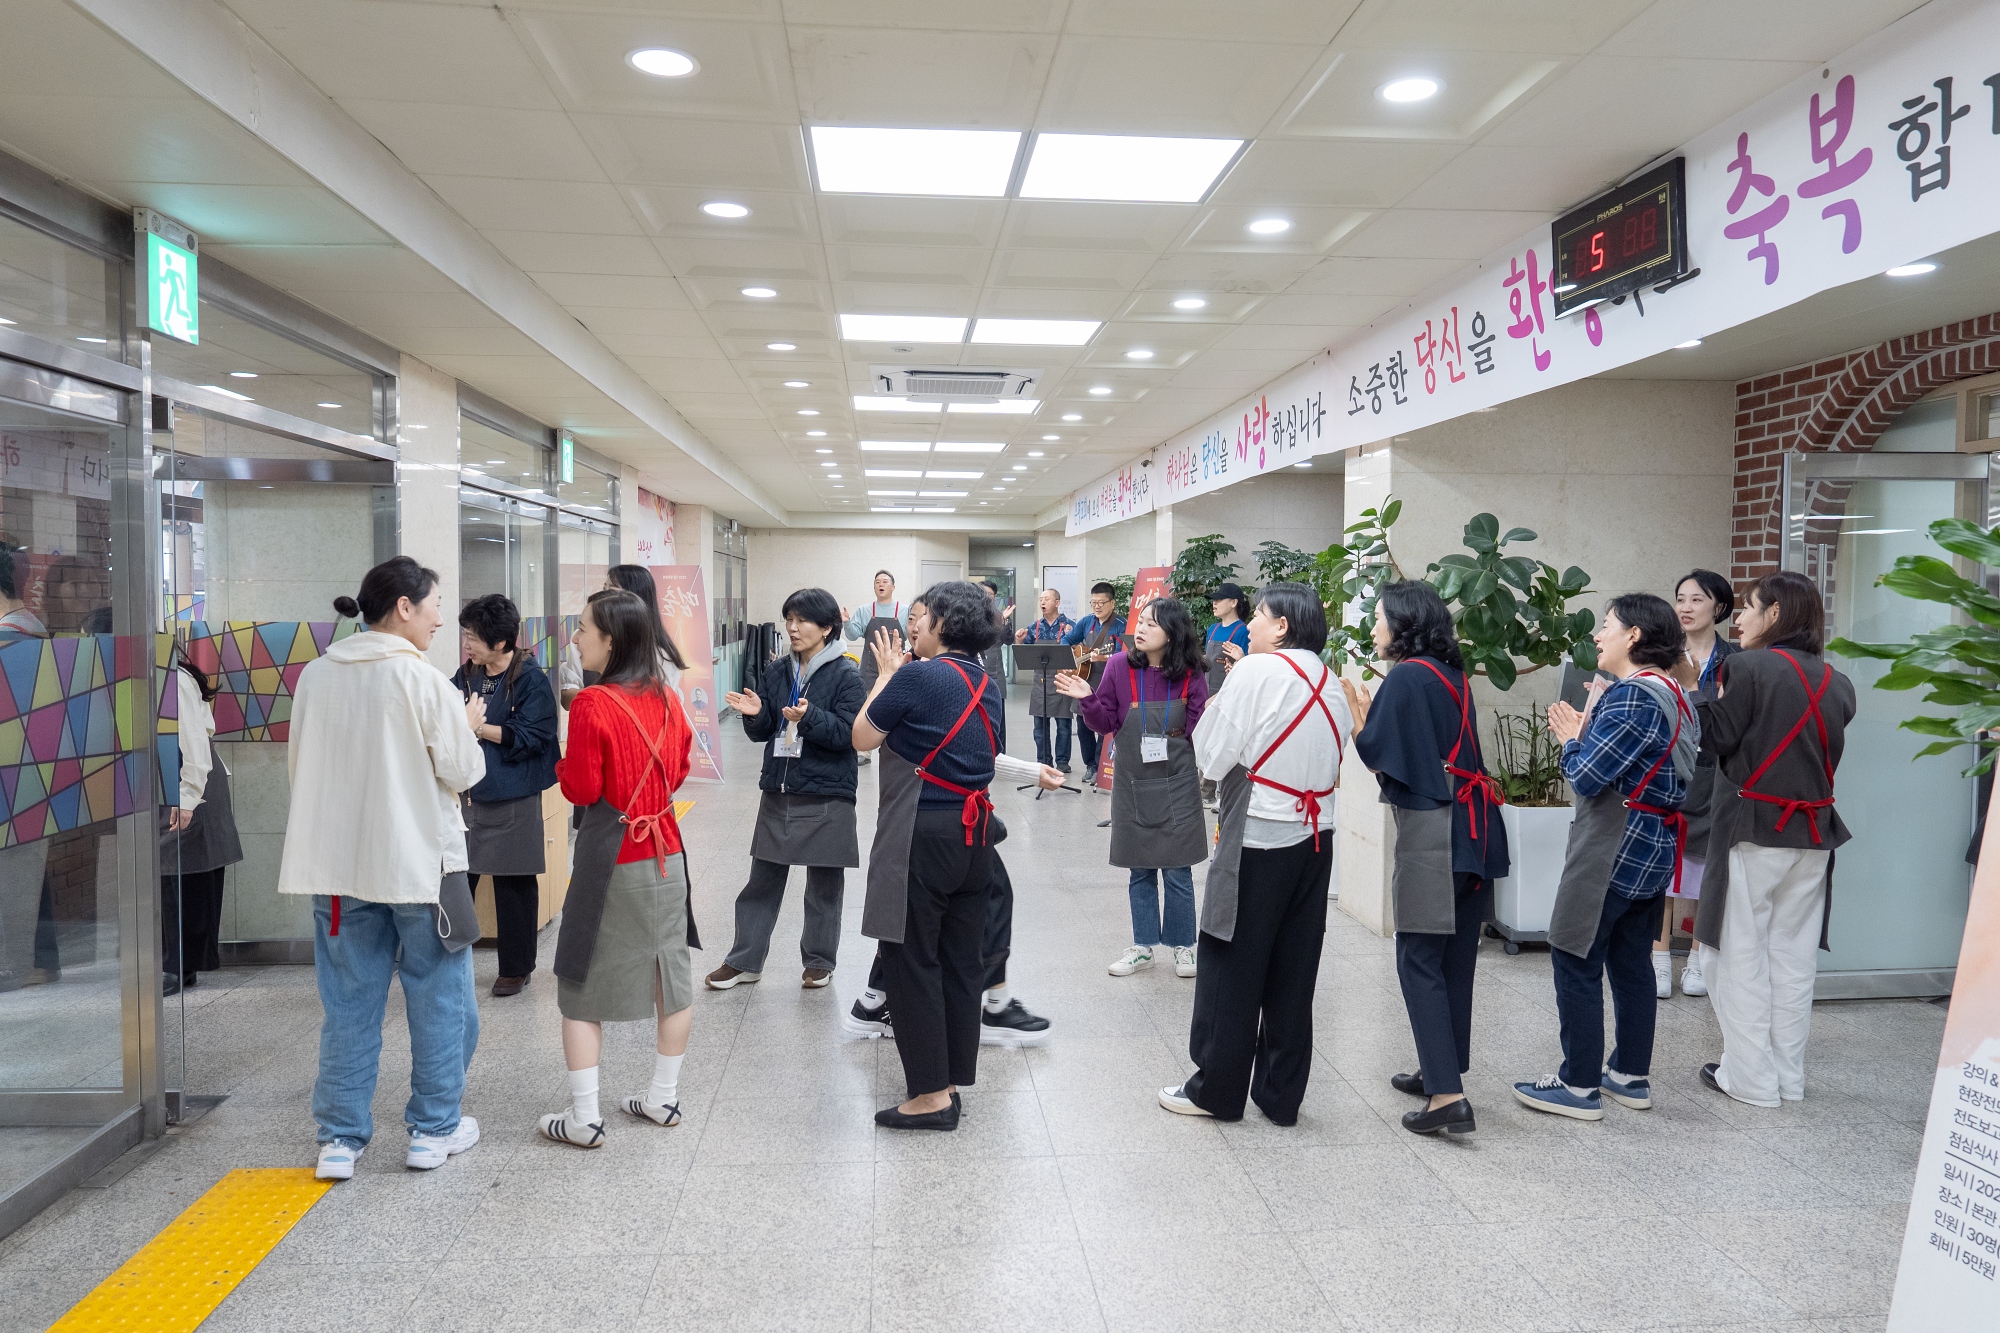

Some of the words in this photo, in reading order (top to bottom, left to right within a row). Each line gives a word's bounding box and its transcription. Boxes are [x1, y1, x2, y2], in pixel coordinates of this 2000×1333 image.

[1597, 203, 1623, 223] PHAROS
[1348, 350, 1407, 416] 소중한
[1413, 306, 1496, 394] 당신을
[1166, 446, 1198, 493] 하나님은
[1202, 430, 1228, 480] 당신을
[1235, 391, 1327, 470] 사랑하십니다
[1118, 465, 1149, 517] 환영합니다
[1963, 1061, 1988, 1084] 강의
[1989, 1073, 1999, 1088] &
[1949, 1130, 1998, 1166] 점심식사
[1944, 1162, 1968, 1187] 일시
[1934, 1209, 1959, 1234] 인원
[1938, 1185, 1963, 1209] 장소
[1971, 1202, 1997, 1227] 본관
[1928, 1232, 1954, 1258] 회비
[1961, 1250, 1996, 1281] 5만원
